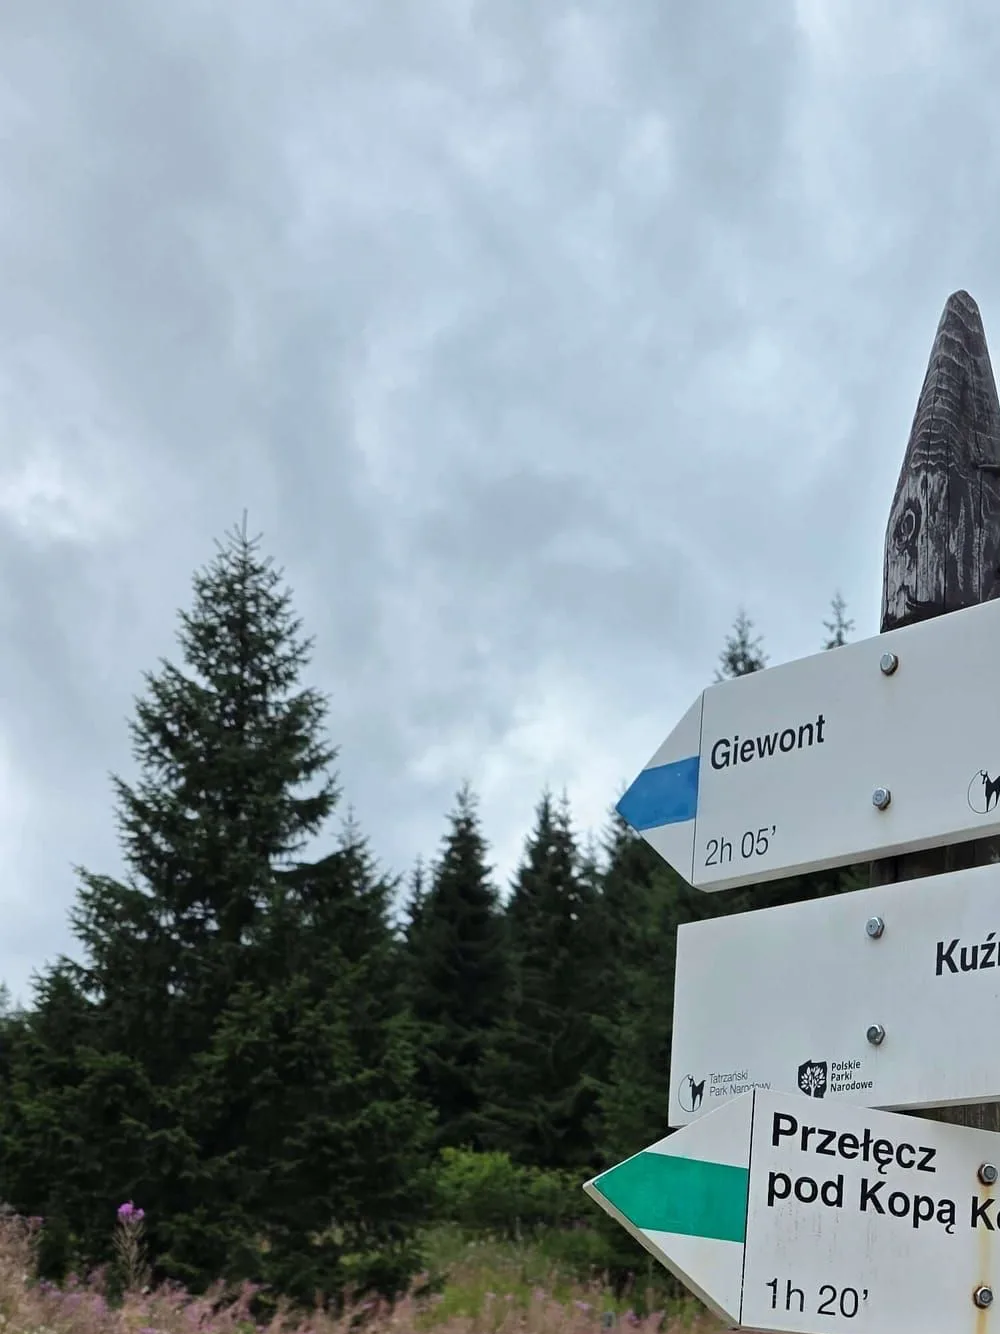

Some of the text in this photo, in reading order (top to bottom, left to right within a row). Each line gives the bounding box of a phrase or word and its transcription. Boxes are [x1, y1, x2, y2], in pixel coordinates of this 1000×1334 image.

[711, 714, 825, 770] Giewont
[705, 837, 732, 866] 2h
[831, 1060, 861, 1072] Polskie
[831, 1071, 852, 1082] Parki
[709, 1070, 749, 1084] Tatrzański
[830, 1080, 873, 1092] Narodowe
[710, 1086, 727, 1096] Park
[772, 1112, 937, 1174] Przełęcz
[767, 1171, 844, 1208] pod
[859, 1178, 956, 1235] Kopą
[765, 1278, 805, 1312] 1h
